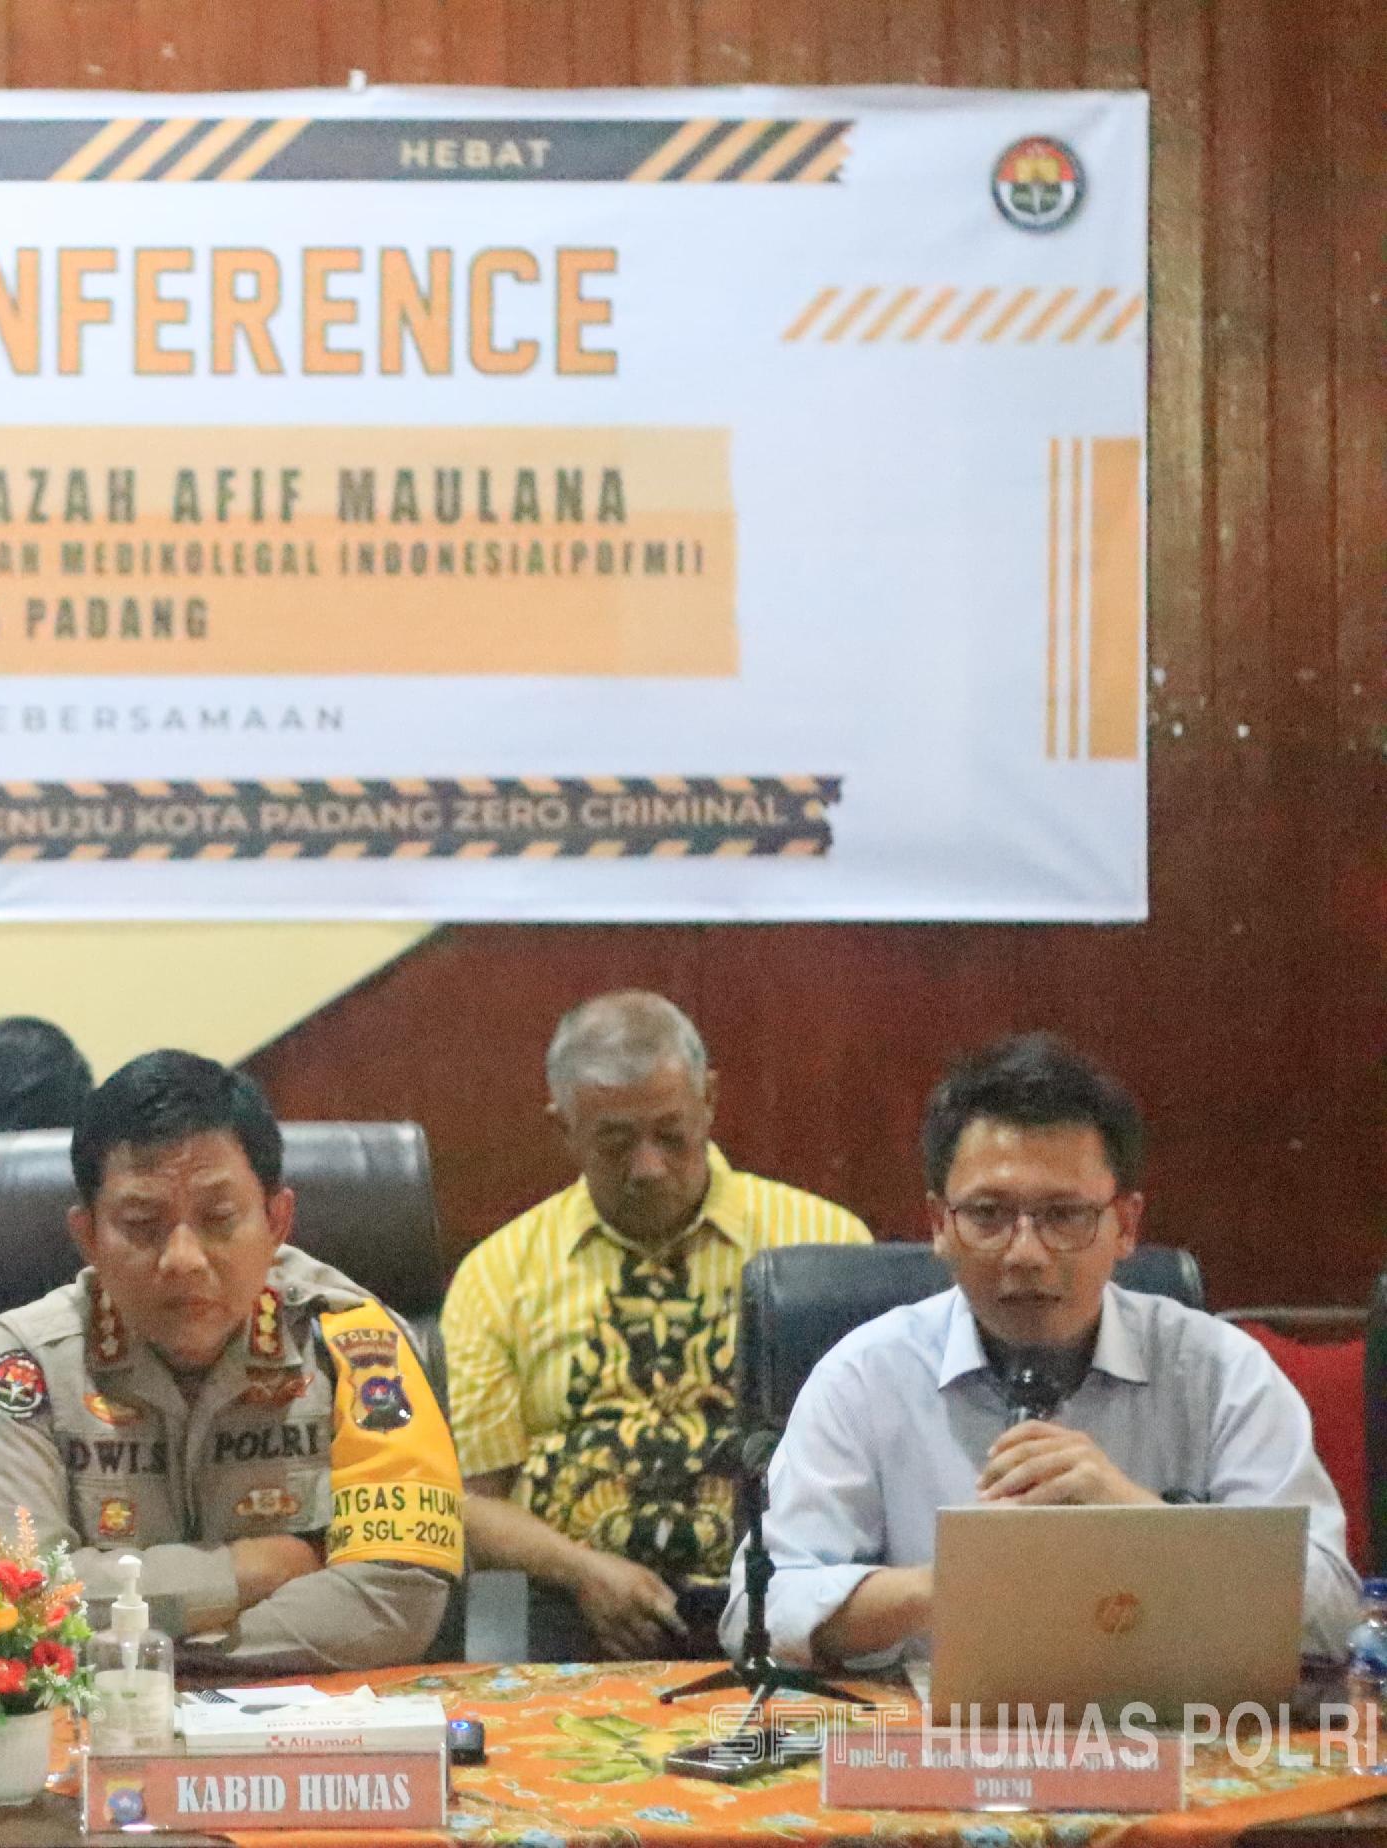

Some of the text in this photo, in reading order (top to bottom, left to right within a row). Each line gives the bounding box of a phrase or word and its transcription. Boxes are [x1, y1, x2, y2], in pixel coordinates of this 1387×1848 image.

[400, 138, 553, 169] HEBAT
[171, 467, 303, 523] AFIF
[337, 467, 628, 524] MAULANA
[60, 540, 320, 576] MEDIKOLEGAL
[25, 597, 209, 640] PADANG
[129, 804, 249, 837] KOTA
[259, 800, 443, 834] PADANG
[452, 798, 570, 830] ZERO
[580, 795, 787, 827] CRIMINAL
[213, 1423, 318, 1462] POLRI
[176, 1772, 412, 1814] KABID HUMAS
